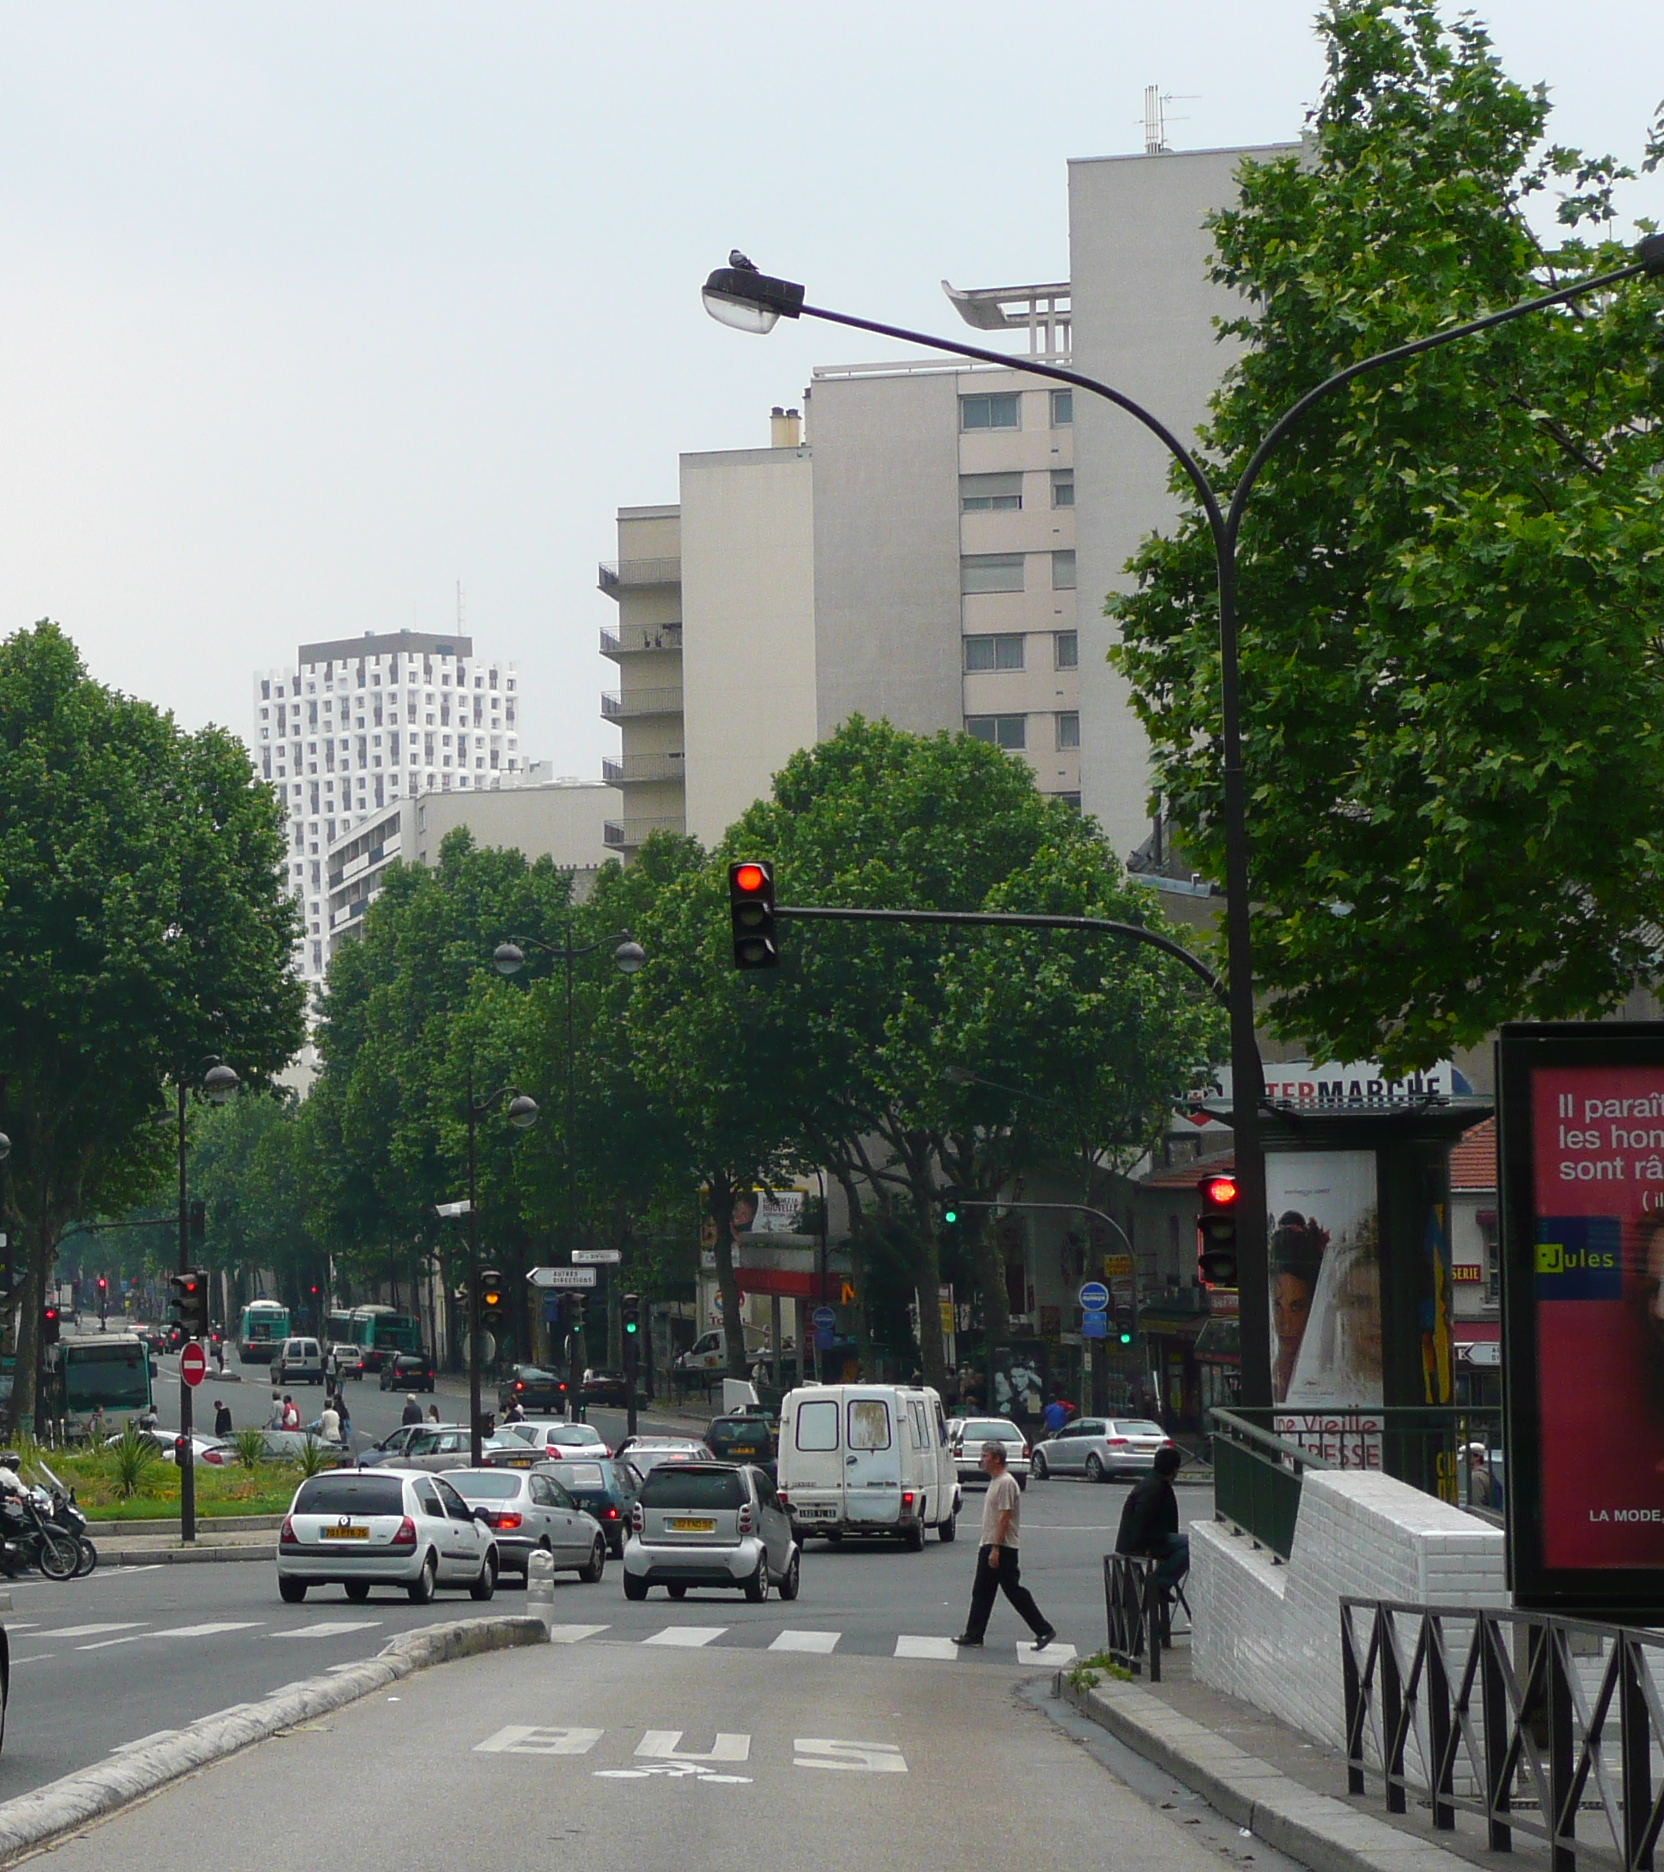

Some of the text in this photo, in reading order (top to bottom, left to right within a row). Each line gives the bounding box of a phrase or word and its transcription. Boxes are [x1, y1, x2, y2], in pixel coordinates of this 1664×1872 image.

[1559, 1094, 1573, 1118] Il
[1559, 1125, 1601, 1149] les
[1559, 1156, 1624, 1180] sont
[1589, 1509, 1610, 1522] LA
[472, 1725, 910, 1773] BUS
